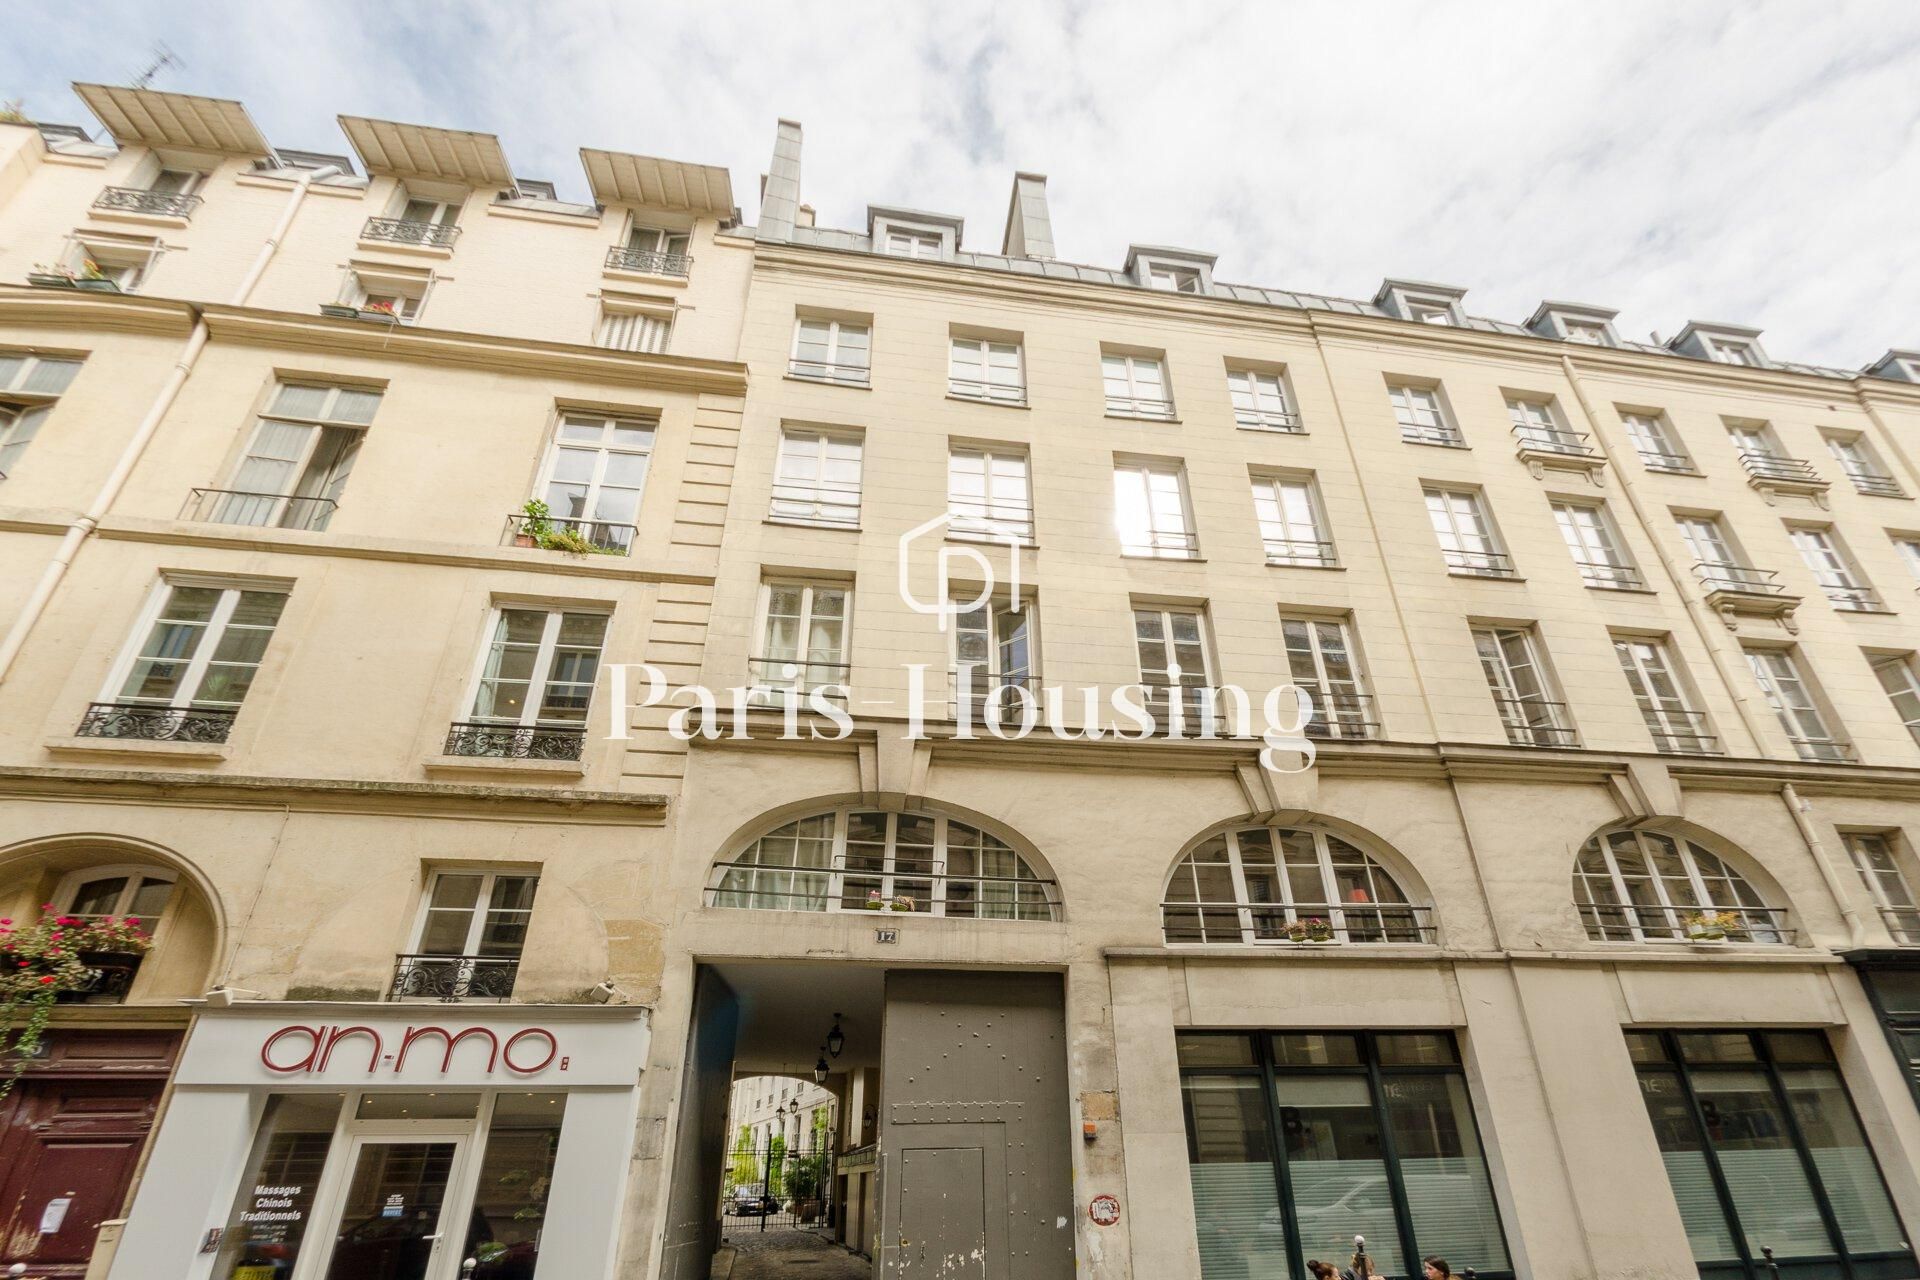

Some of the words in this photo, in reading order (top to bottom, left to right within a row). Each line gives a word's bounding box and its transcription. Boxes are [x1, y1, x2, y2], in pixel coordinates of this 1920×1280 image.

[261, 1025, 559, 1074] an-mo
[254, 1185, 301, 1196] Massages
[255, 1198, 292, 1208] Chinois
[239, 1211, 301, 1221] Traditionnels
